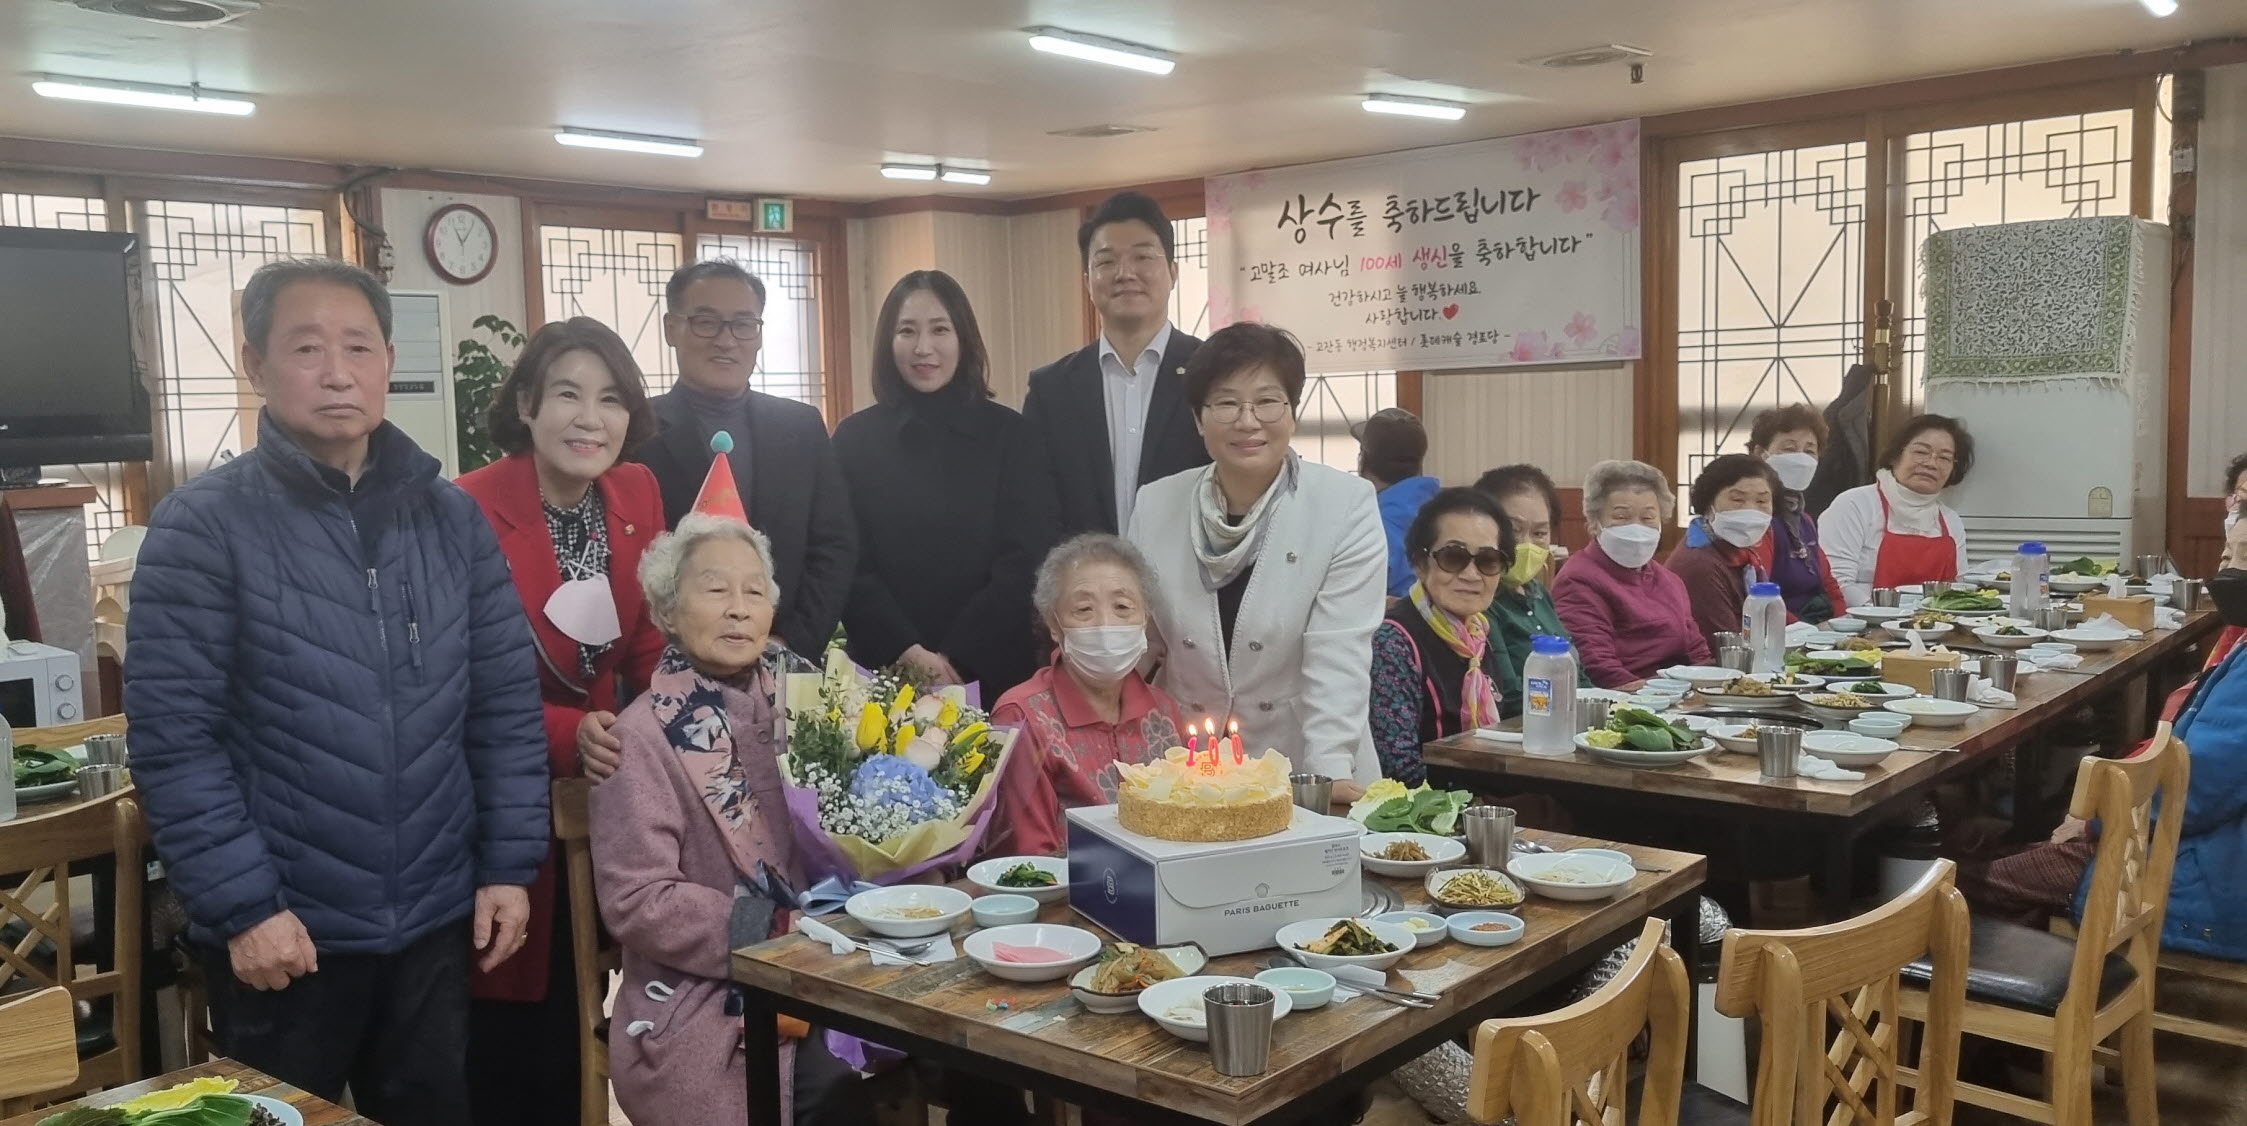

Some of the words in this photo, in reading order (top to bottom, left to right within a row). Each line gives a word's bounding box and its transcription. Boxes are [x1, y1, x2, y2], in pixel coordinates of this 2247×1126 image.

[1277, 192, 1367, 244] 상수를
[1383, 187, 1541, 233] 축하드립니다
[1299, 255, 1350, 277] 여사님
[1360, 253, 1402, 272] 100세
[1413, 243, 1466, 271] 생신을
[1328, 289, 1392, 307] 건강하시고
[1396, 284, 1408, 304] 늘
[1347, 337, 1408, 352] 행정복지센터
[1224, 908, 1251, 917] PARIS
[1253, 899, 1300, 913] BAGUETTE
